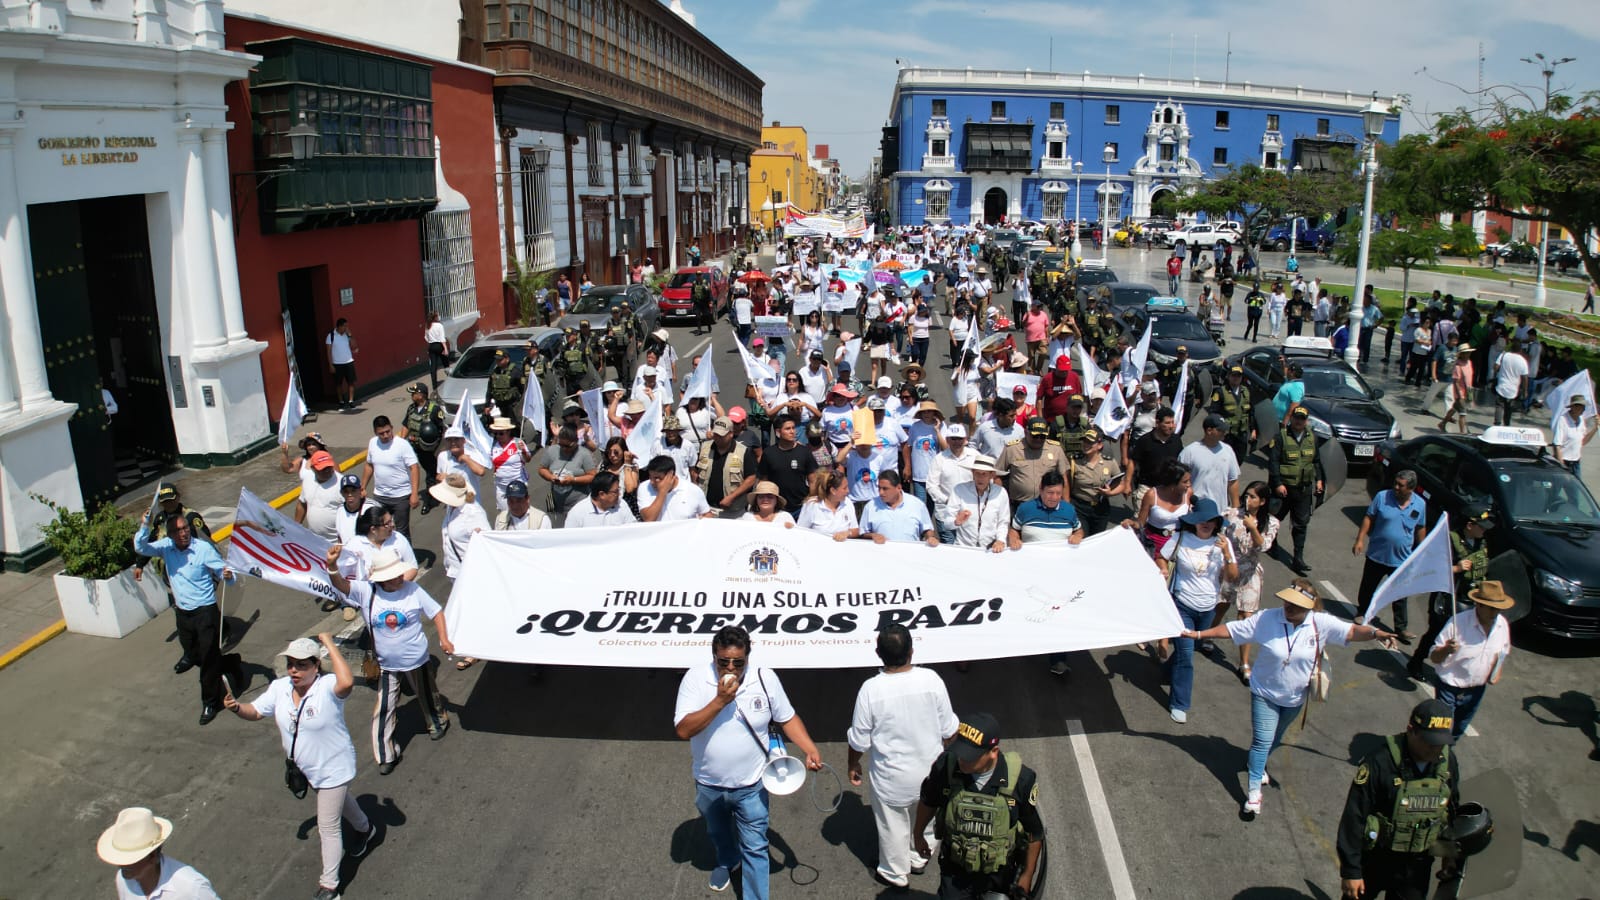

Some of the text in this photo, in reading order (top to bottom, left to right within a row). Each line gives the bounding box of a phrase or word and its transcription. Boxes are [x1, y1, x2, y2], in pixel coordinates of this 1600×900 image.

[38, 136, 157, 149] GOBIERNO REGIONAL
[62, 152, 139, 166] LA LIBERTAD
[604, 586, 922, 608] ¡TRUJILLO UNA SOLA FUERZA!
[517, 598, 1003, 634] ¡QUEREMOS PAZ!
[761, 639, 805, 647] Trujillo
